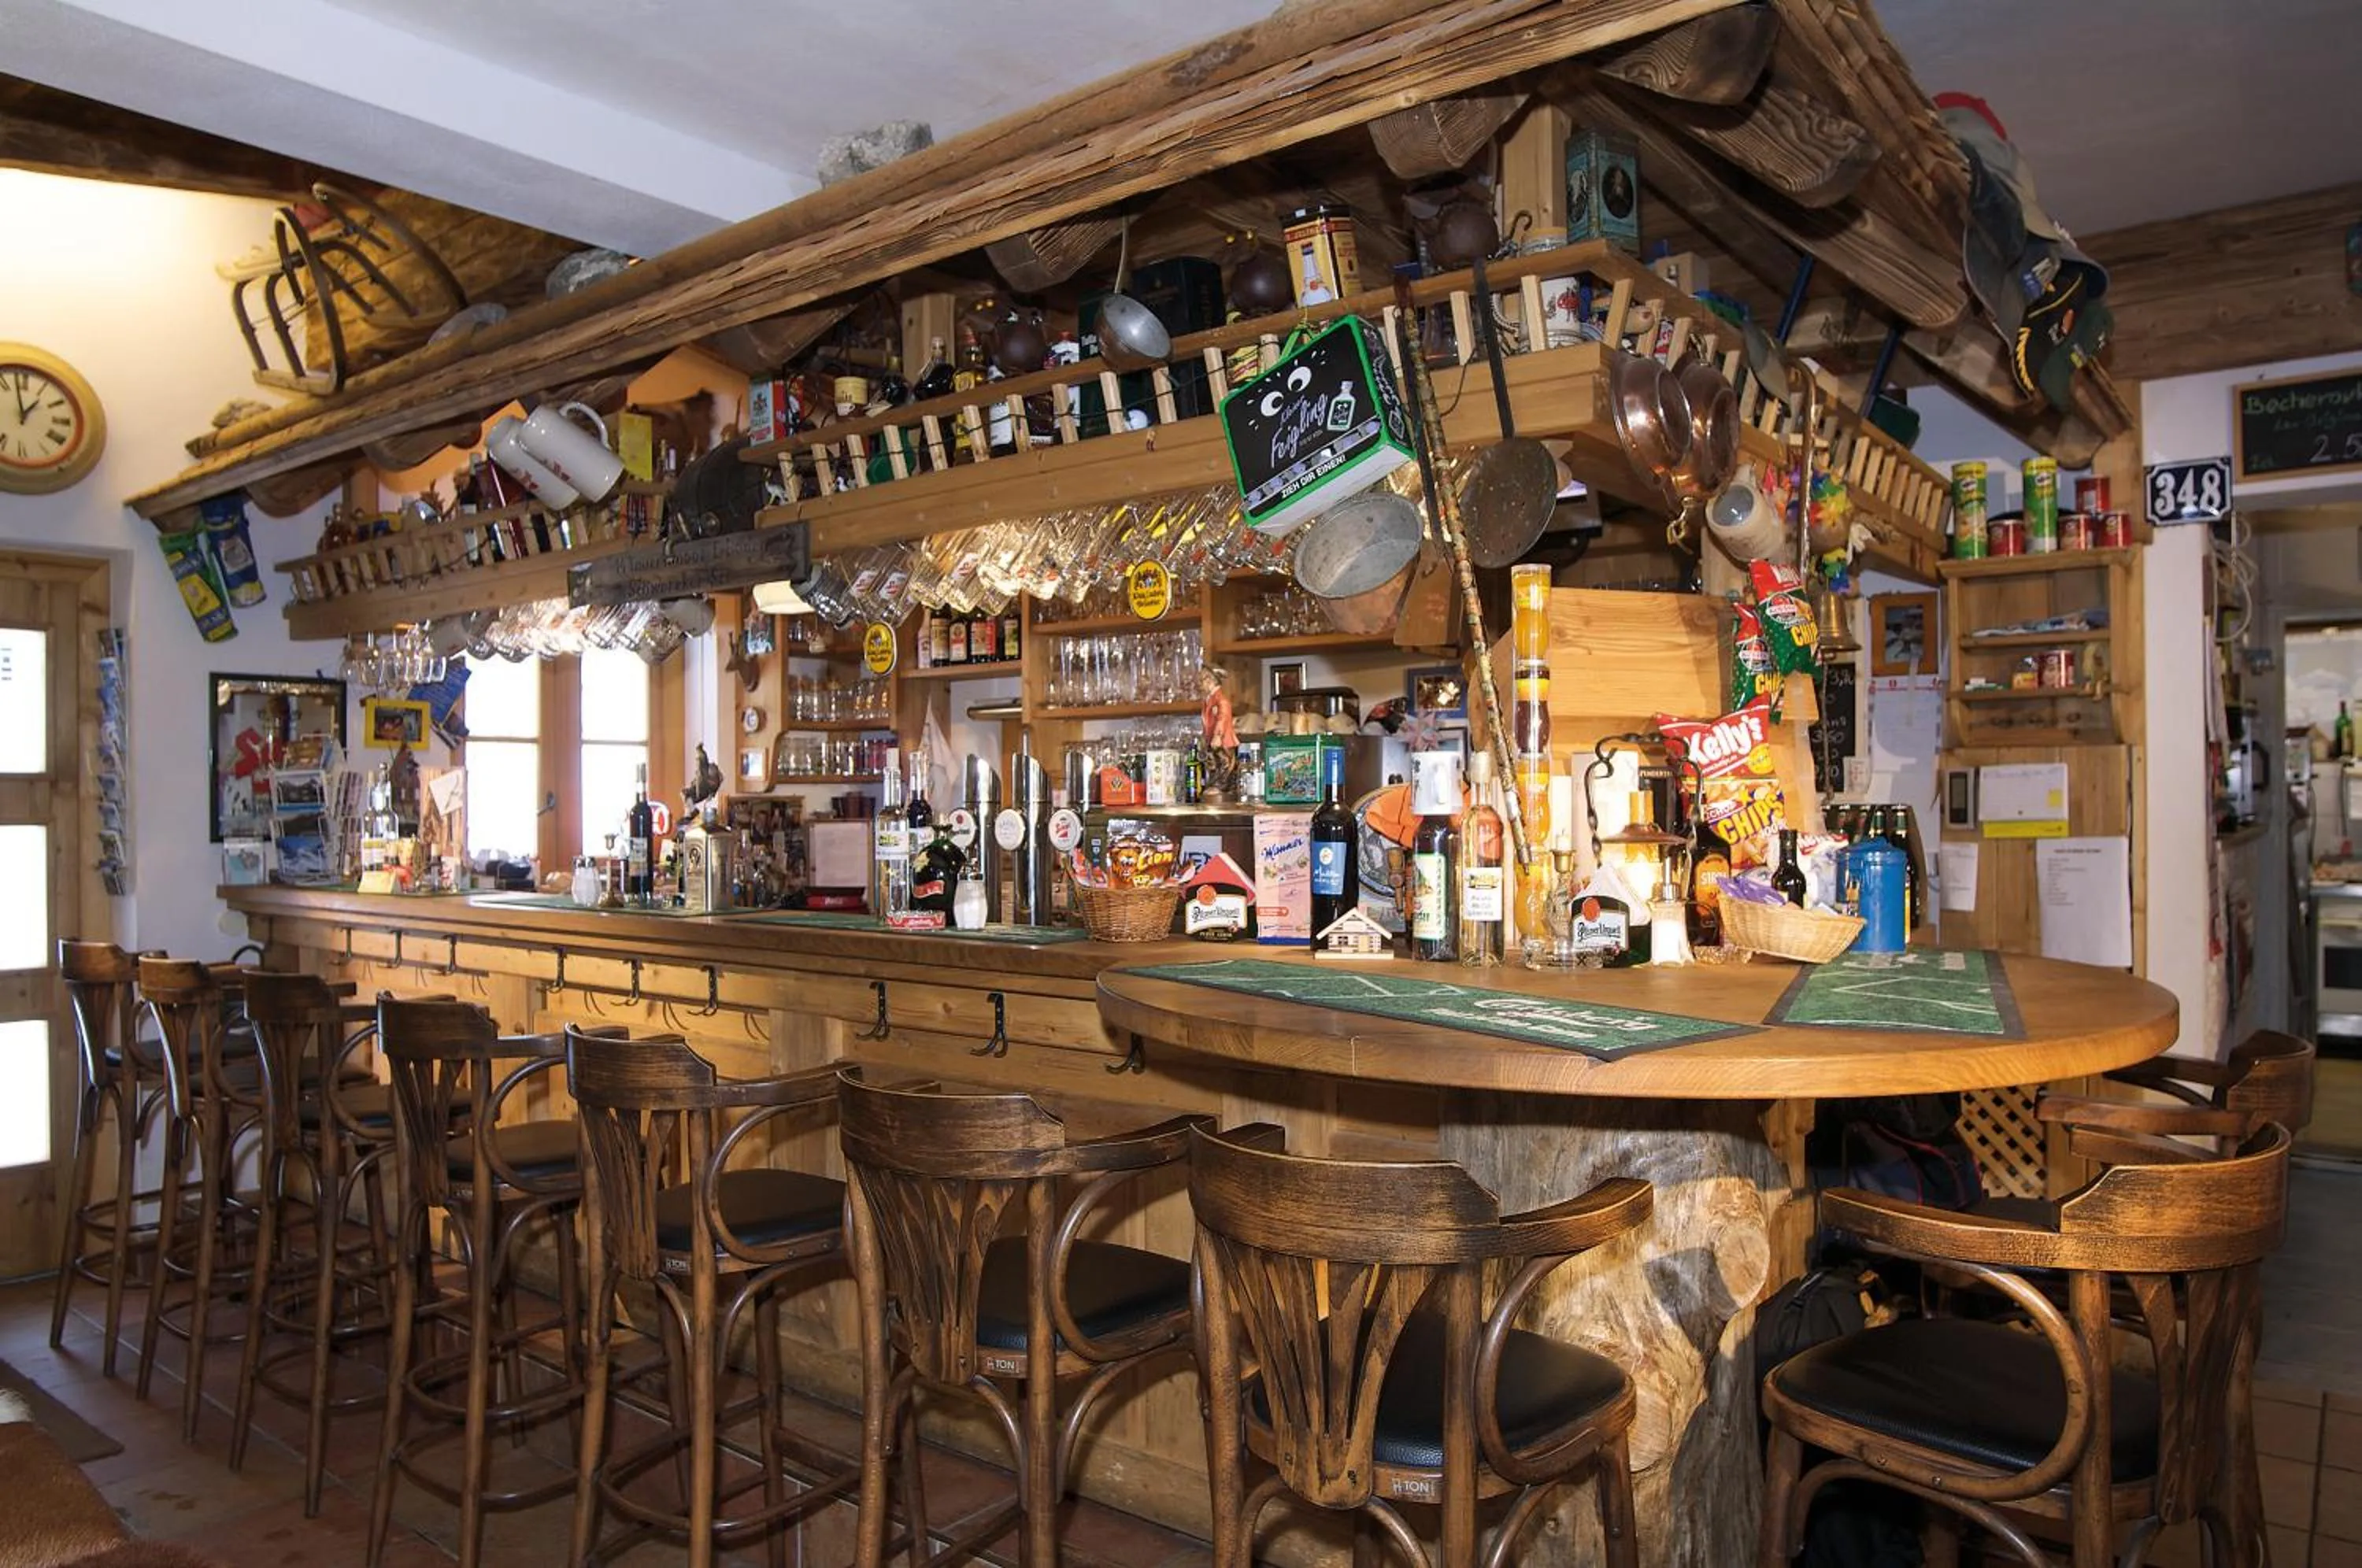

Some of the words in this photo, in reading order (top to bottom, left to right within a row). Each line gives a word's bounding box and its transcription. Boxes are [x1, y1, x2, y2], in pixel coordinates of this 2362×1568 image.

[1271, 394, 1328, 468] Feigling
[1282, 482, 1300, 498] ZIEH
[1300, 472, 1316, 486] DIR
[1316, 455, 1346, 478] EINEN!
[2154, 468, 2221, 517] 348
[1683, 715, 1763, 764] Kelly's
[1717, 793, 1784, 845] CHIPS
[1403, 1481, 1429, 1493] TON
